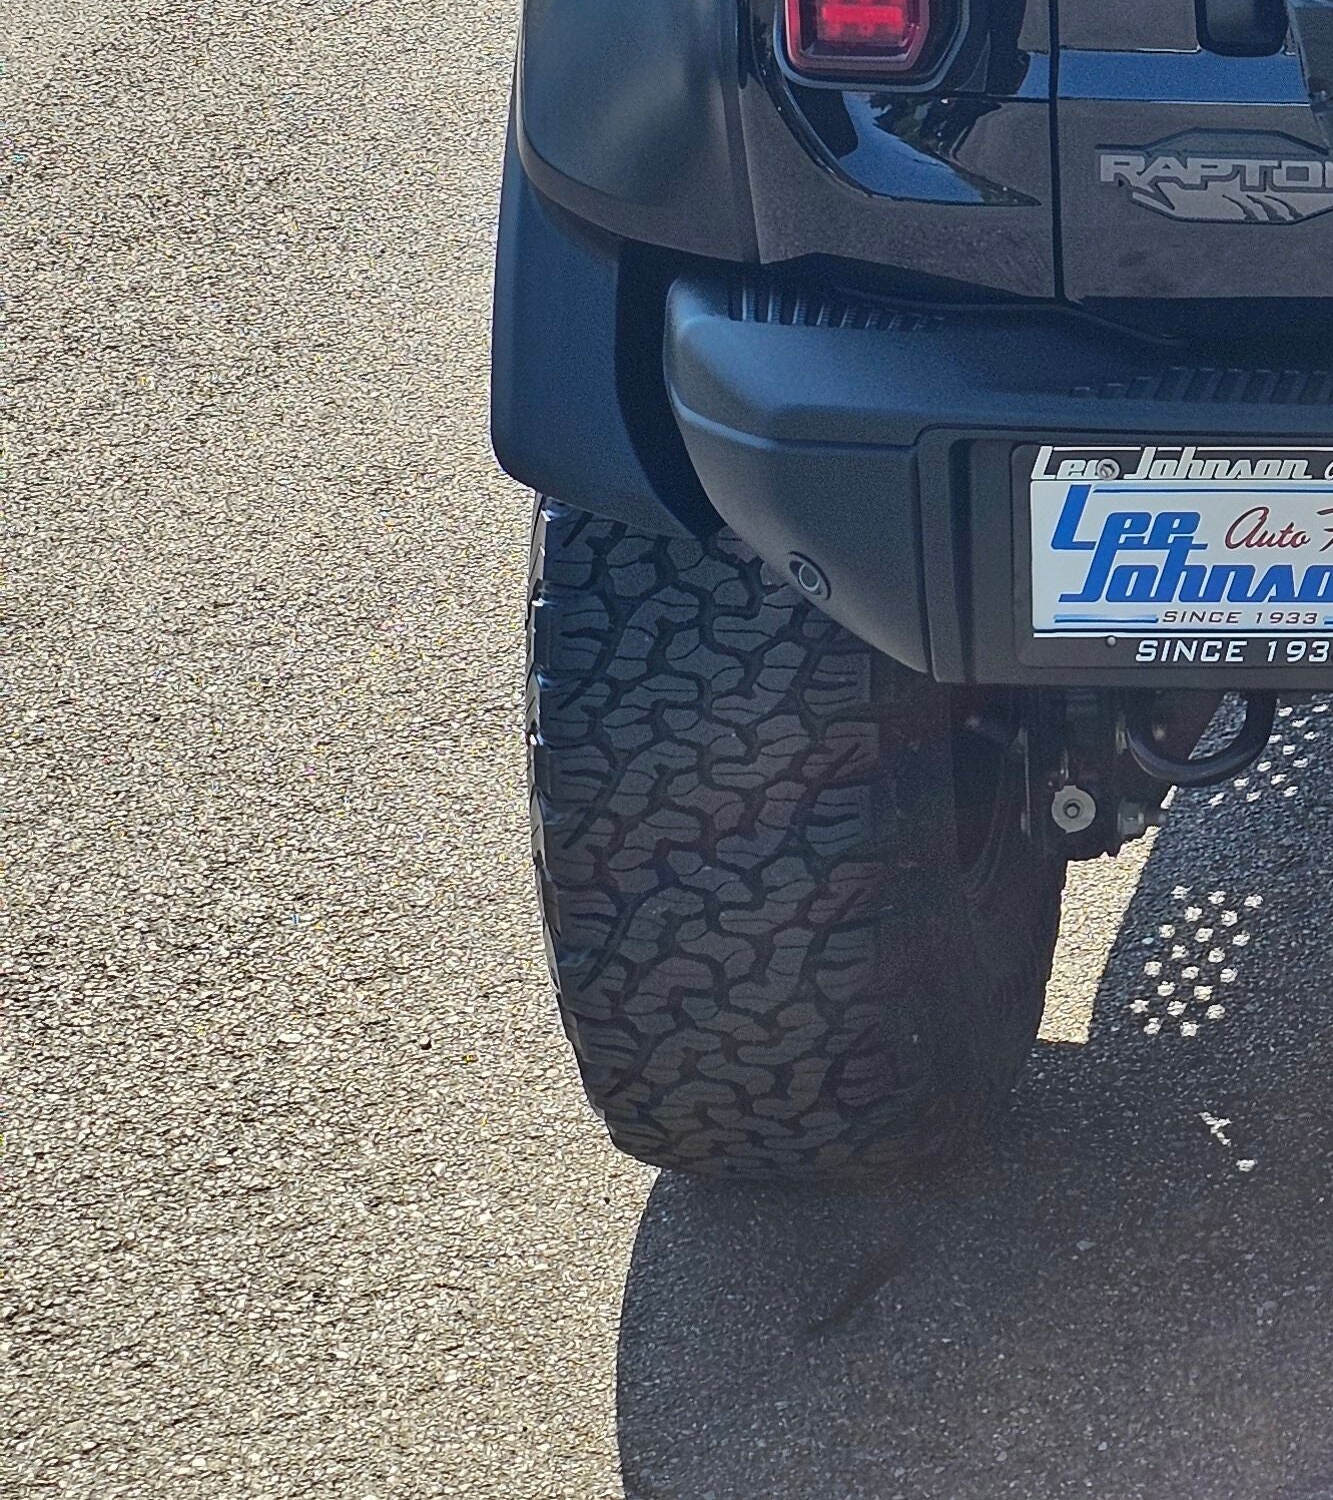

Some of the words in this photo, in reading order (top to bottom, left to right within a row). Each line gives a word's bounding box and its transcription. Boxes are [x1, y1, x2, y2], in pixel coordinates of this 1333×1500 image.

[1123, 446, 1313, 480] Johnson
[1051, 484, 1208, 550] Lee
[1225, 507, 1310, 552] Auto
[1162, 610, 1242, 624] SINCE
[1256, 611, 1318, 625] 1933
[1135, 640, 1248, 663] SINCE
